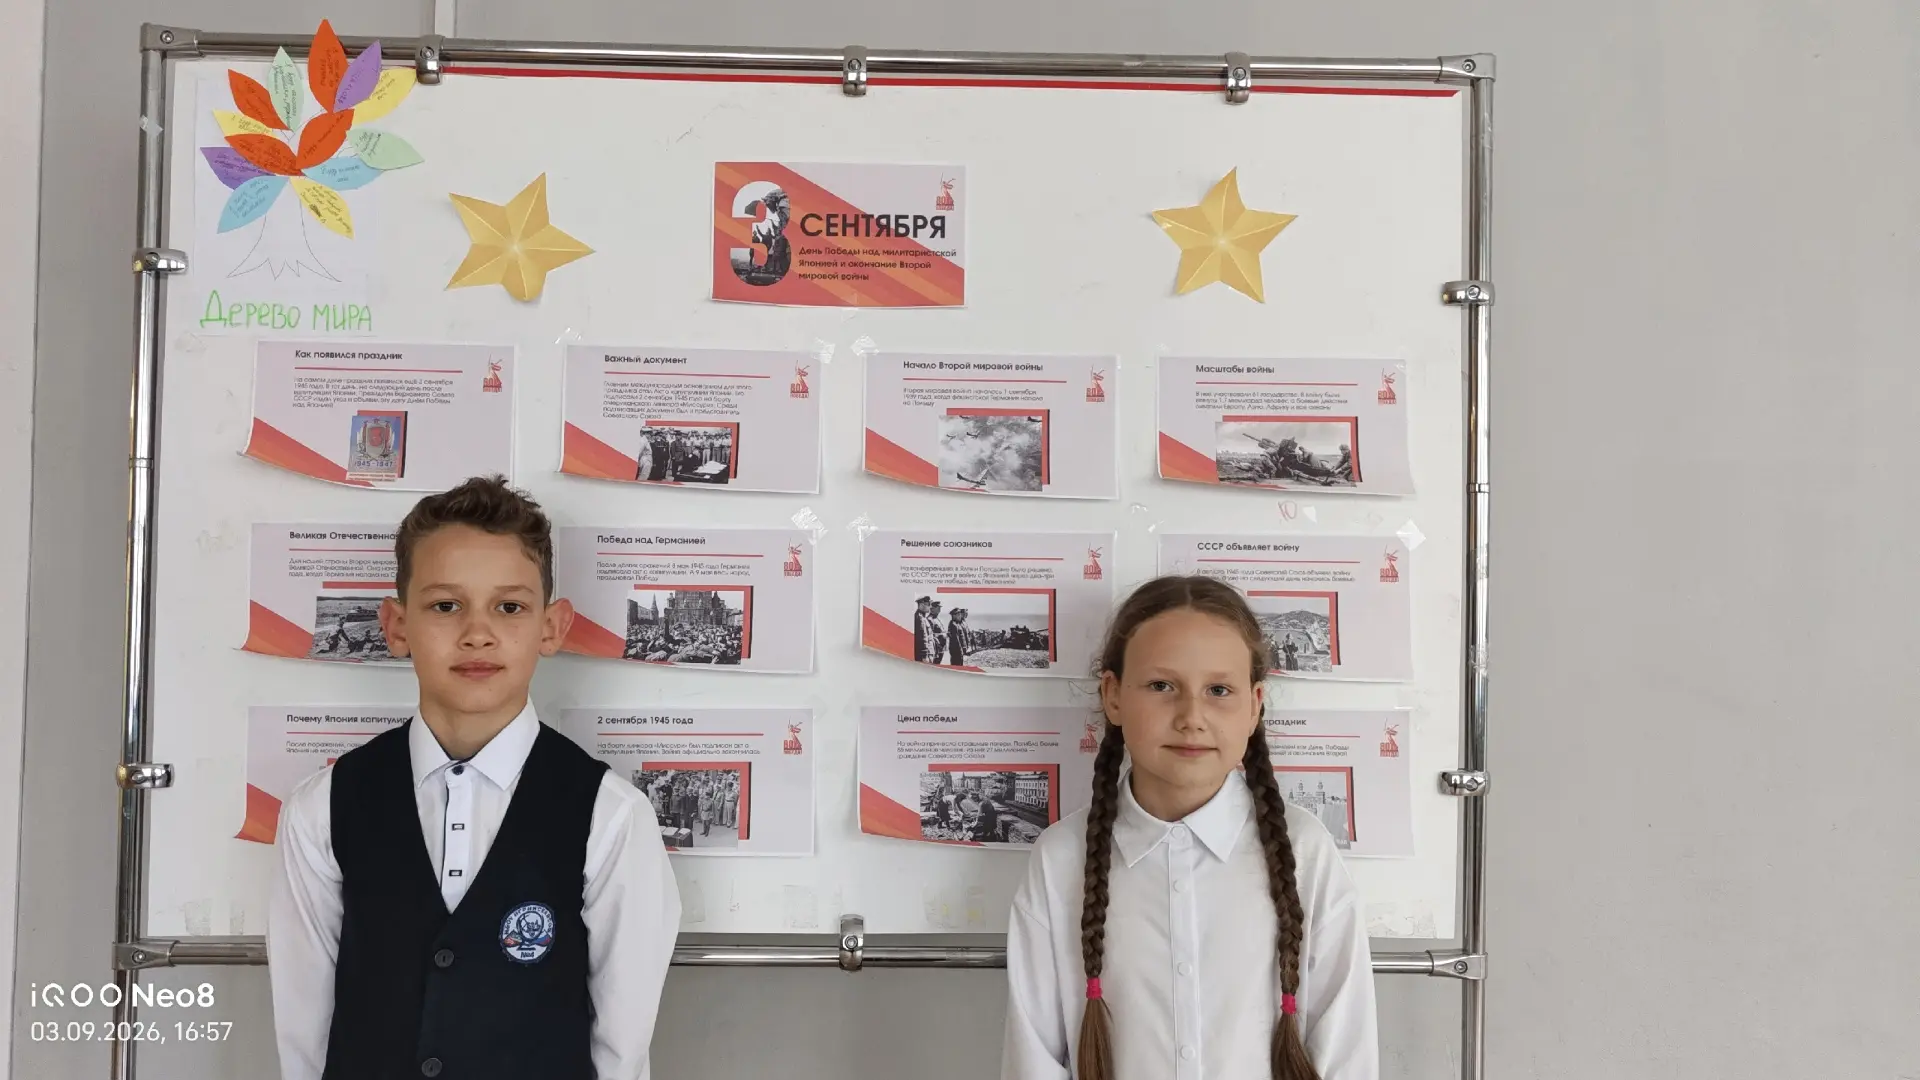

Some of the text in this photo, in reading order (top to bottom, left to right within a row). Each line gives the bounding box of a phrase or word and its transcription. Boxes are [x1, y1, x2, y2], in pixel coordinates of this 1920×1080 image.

[730, 180, 946, 286] 3 СЕНТЯБРЯ
[799, 247, 957, 258] День Победы над милитаристской
[798, 260, 838, 268] Японией
[899, 261, 932, 270] Второй
[798, 273, 838, 281] мировой
[295, 350, 311, 358] Как
[358, 352, 403, 360] праздник
[605, 355, 687, 365] Важный документ
[903, 361, 1043, 371] Начало Второй мировой войны
[1196, 365, 1275, 374] Масштабы войны
[289, 531, 397, 540] Великая Отечественна
[597, 535, 632, 544] Победа
[655, 536, 705, 545] Германией
[900, 539, 941, 547] Решение
[1197, 543, 1300, 552] СССР объявляет войну
[287, 714, 322, 724] Почему
[325, 715, 358, 723] Япония
[597, 716, 603, 724] 2
[605, 716, 647, 725] сентября
[650, 716, 670, 724] 1945
[897, 714, 958, 723] Цена победы
